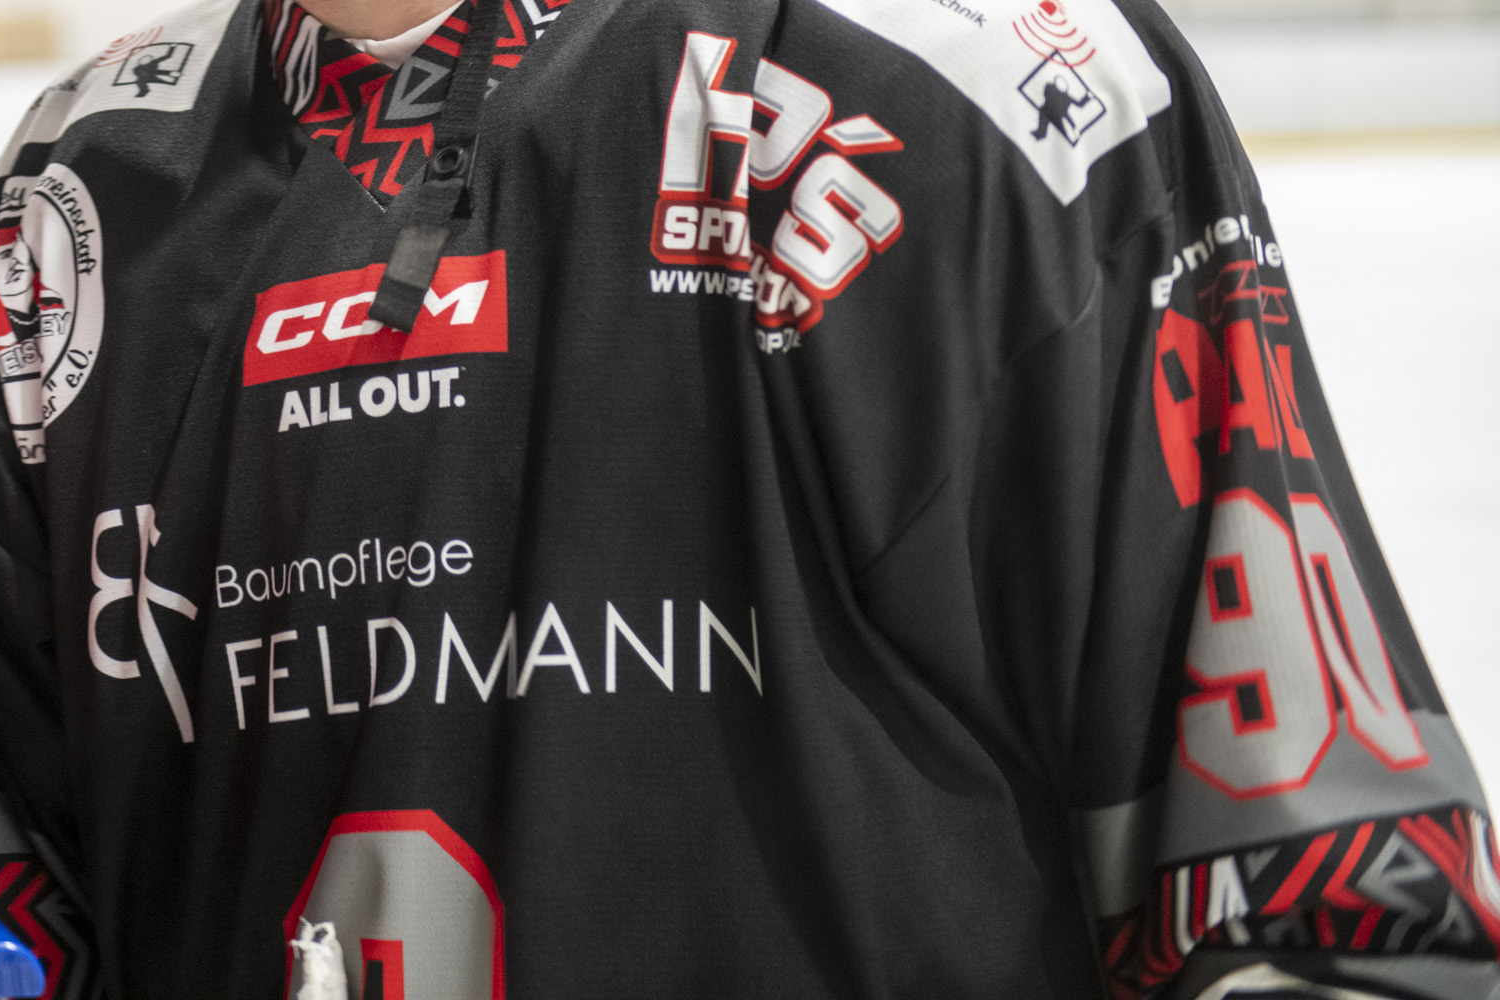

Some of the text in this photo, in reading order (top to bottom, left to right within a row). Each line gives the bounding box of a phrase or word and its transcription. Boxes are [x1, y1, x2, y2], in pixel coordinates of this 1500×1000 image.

[257, 280, 489, 354] CCM
[278, 366, 466, 432] ALL OUT.
[215, 539, 474, 608] Baumpflege
[226, 599, 763, 731] FELDMANN
[1178, 486, 1431, 801] 90
